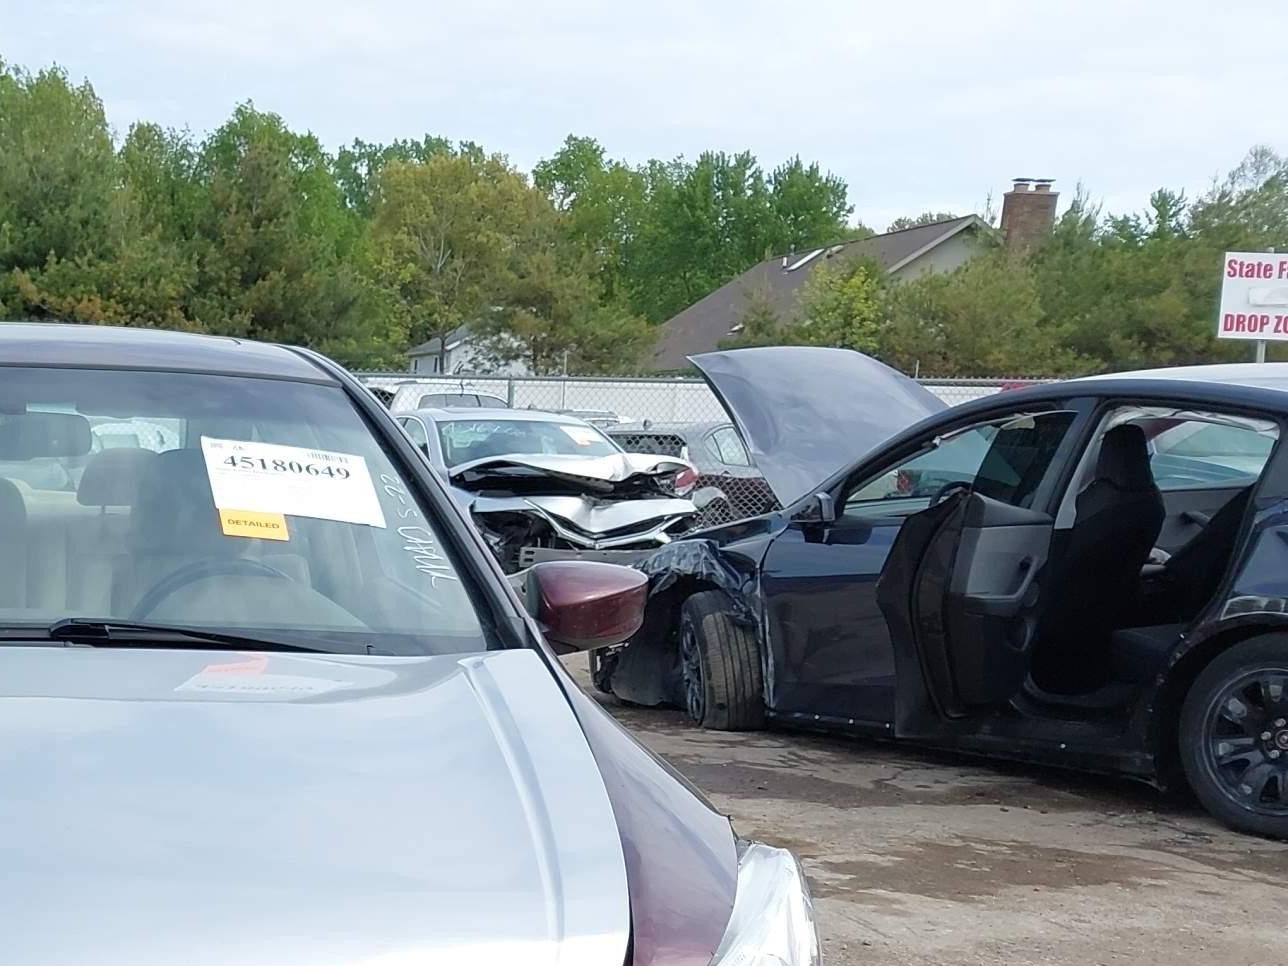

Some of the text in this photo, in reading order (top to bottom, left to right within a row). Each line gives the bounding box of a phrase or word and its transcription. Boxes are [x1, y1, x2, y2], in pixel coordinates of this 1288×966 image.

[1227, 259, 1288, 279] State F
[1223, 314, 1270, 333] DROP
[223, 455, 351, 480] 45180649
[227, 518, 281, 530] DETAILED
